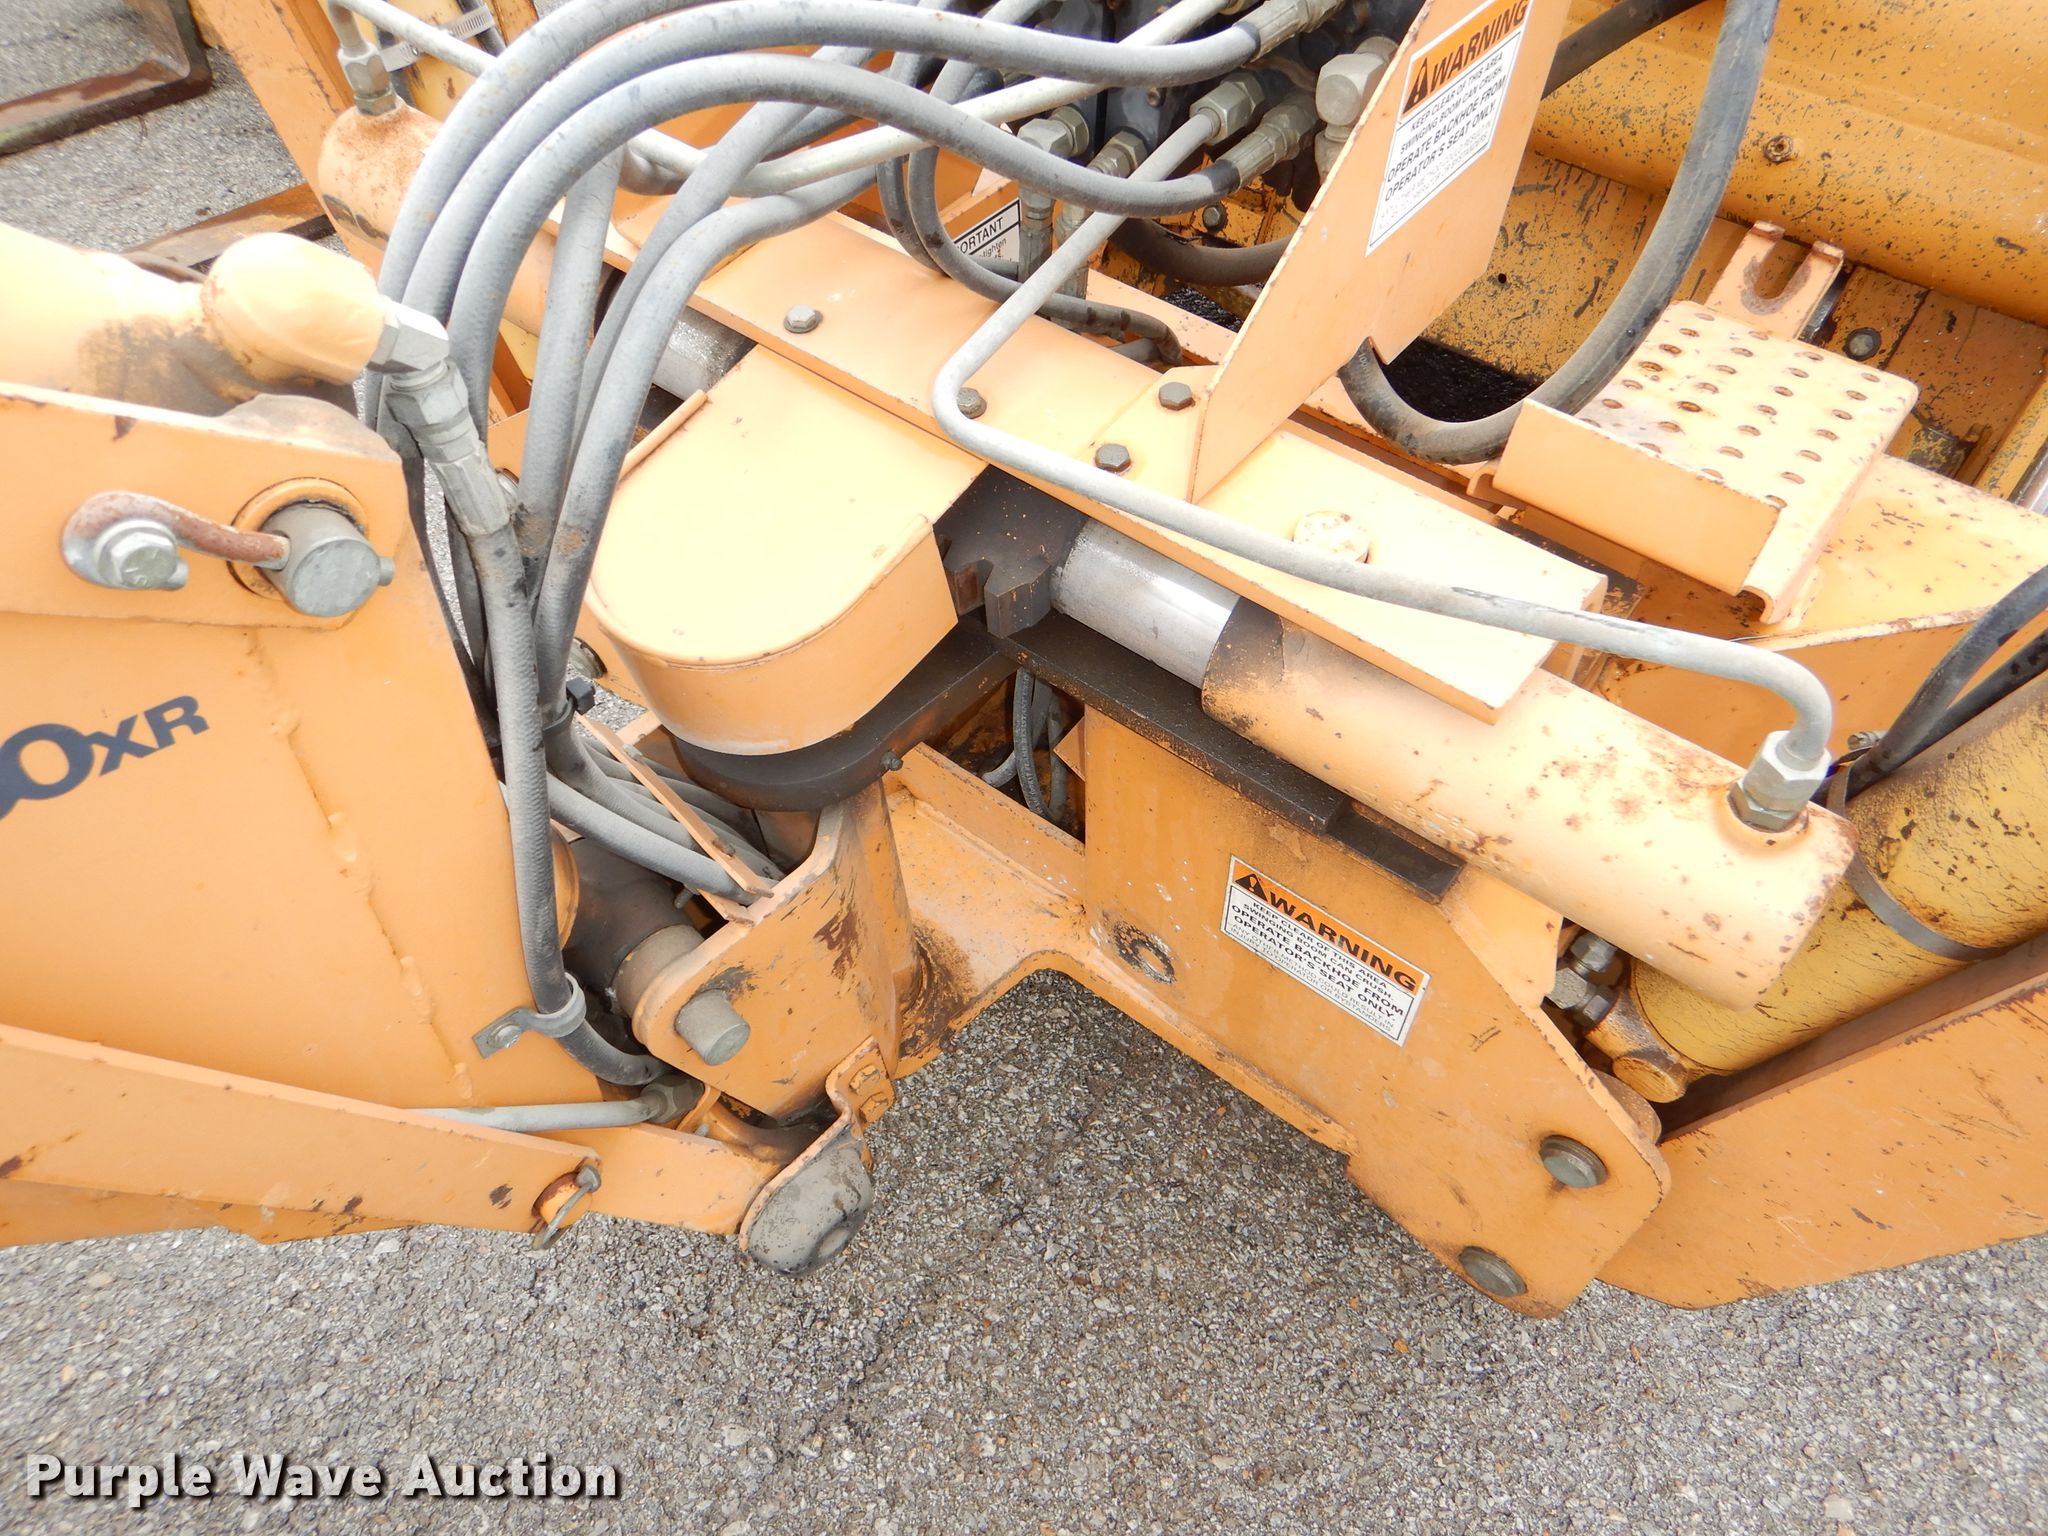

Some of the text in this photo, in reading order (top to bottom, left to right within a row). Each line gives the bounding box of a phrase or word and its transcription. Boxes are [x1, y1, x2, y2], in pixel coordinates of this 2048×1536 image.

[1430, 0, 1528, 93] WARNING
[1385, 143, 1444, 200] OPERATOR'S
[1447, 121, 1470, 148] SEAT
[1387, 136, 1431, 182] OPERATE
[1433, 98, 1478, 144] BACKHOE
[1479, 76, 1505, 105] FROM
[957, 216, 1003, 254] ORTANT
[1232, 904, 1403, 1015] OPERATE BACKHOE FROM
[1234, 915, 1314, 969] OPERATOR'S
[1319, 969, 1352, 993] SEAT
[1244, 904, 1292, 937] SWINGING
[1297, 937, 1326, 957] BOOM
[1330, 958, 1351, 973] CAN
[1253, 902, 1386, 988] KEEP CLEAR OF THIS AREA
[1270, 891, 1417, 992] WARNING
